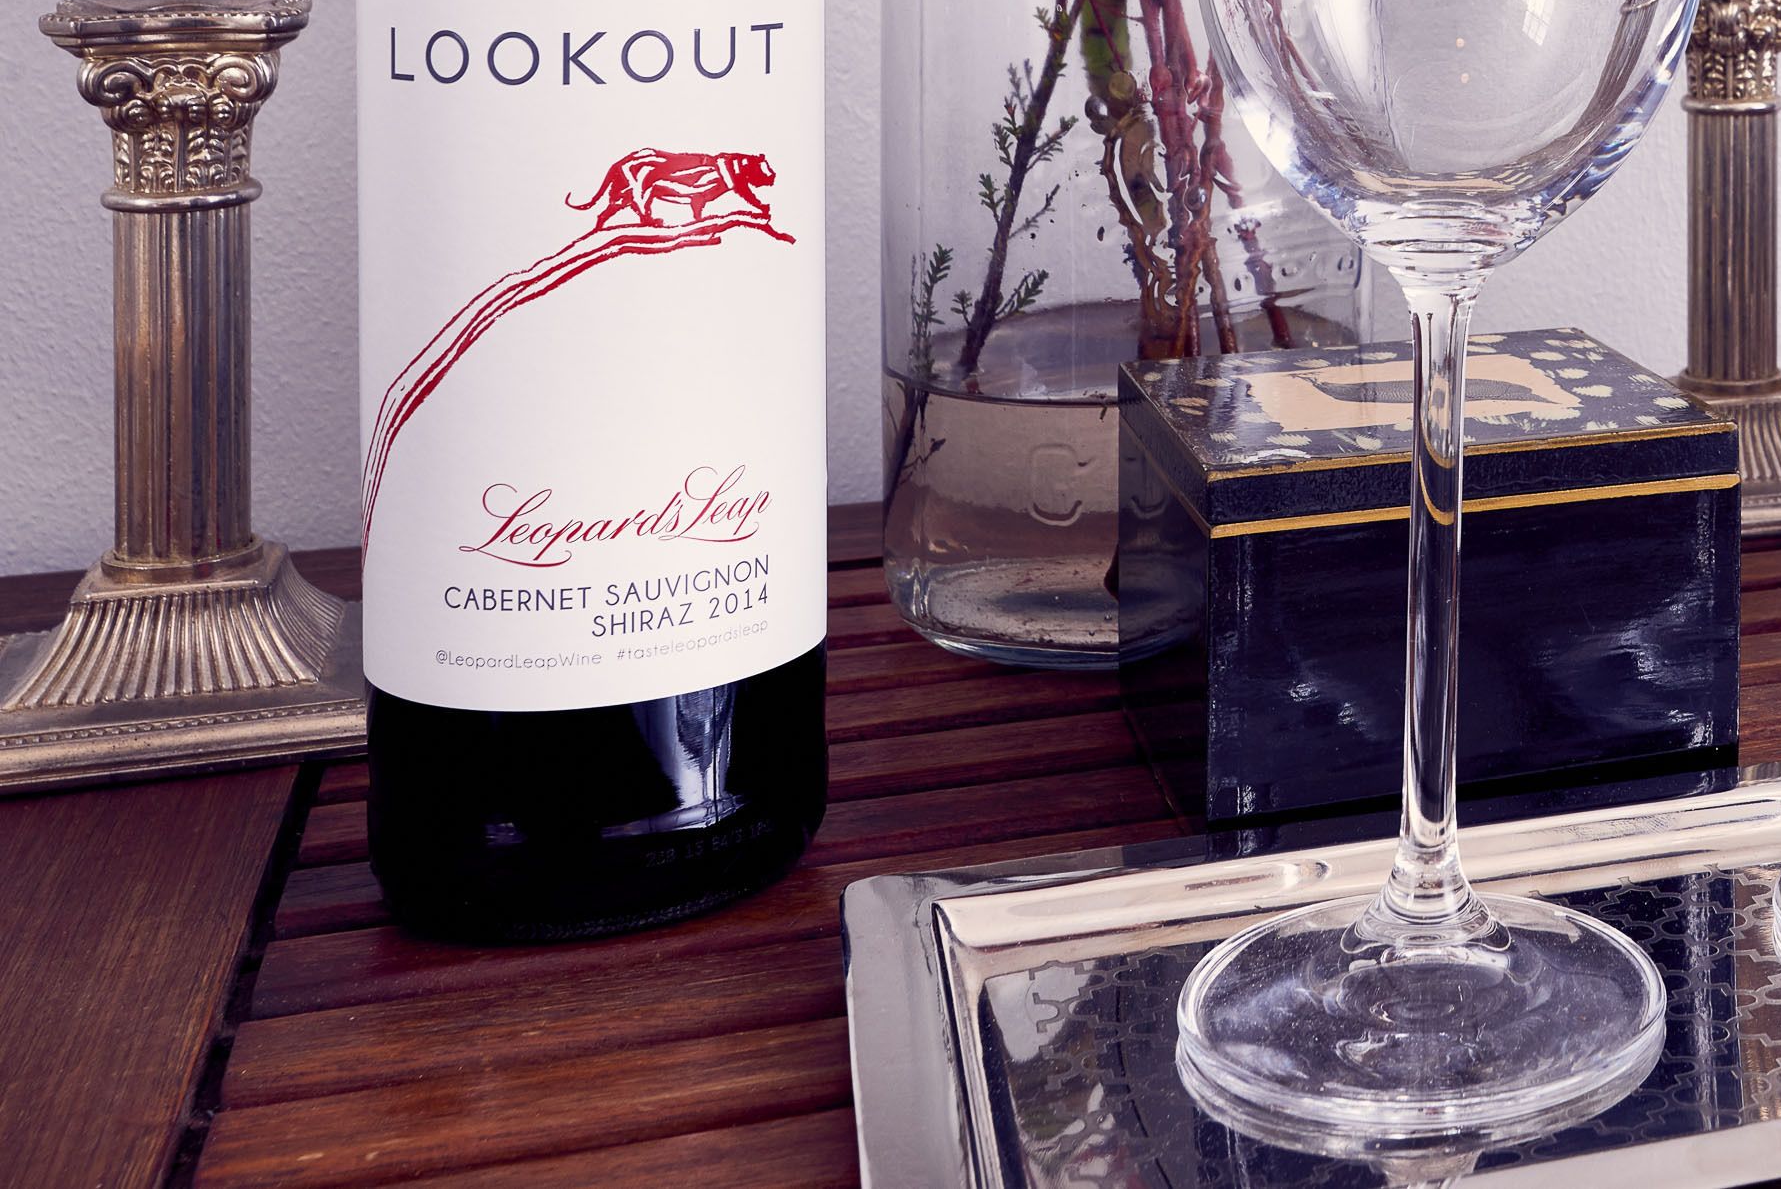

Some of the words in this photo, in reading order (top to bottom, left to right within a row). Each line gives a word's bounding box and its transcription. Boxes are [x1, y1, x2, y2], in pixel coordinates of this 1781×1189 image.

[390, 22, 784, 86] LOOKOUT
[458, 483, 684, 568] Leopard's
[658, 464, 773, 543] Leap
[444, 585, 592, 612] CABERNET
[605, 554, 770, 607] SAUVIGNON
[591, 602, 694, 638] SHIRAZ
[708, 582, 769, 620] 2014
[435, 649, 602, 671] @LeopardLeapWine
[616, 620, 769, 660] #tasteleopardsleap
